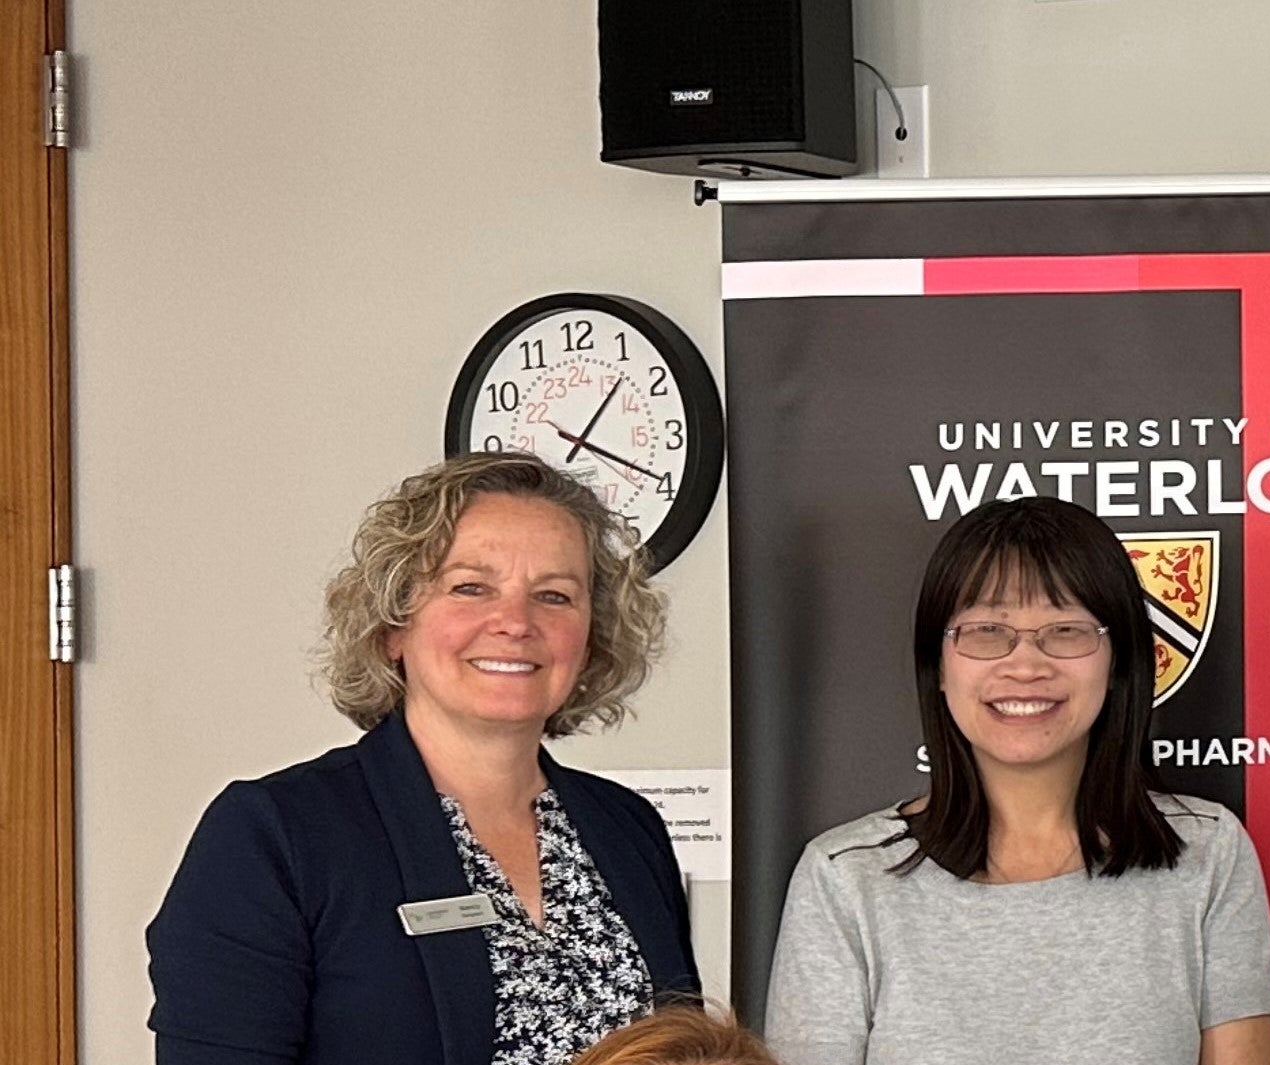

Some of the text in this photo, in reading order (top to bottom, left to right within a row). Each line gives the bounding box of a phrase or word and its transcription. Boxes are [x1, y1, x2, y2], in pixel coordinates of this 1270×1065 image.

[560, 320, 594, 352] 12
[614, 332, 631, 362] 1
[519, 339, 547, 371] 11
[543, 377, 567, 400] 23
[567, 366, 593, 388] 24
[648, 366, 668, 397] 2
[486, 381, 519, 413] 10
[622, 394, 641, 415] 14
[526, 402, 549, 425] 22
[630, 426, 648, 448] 15
[664, 419, 684, 451] 3
[939, 417, 1249, 451] UNIVERSITY
[655, 471, 676, 501] 4
